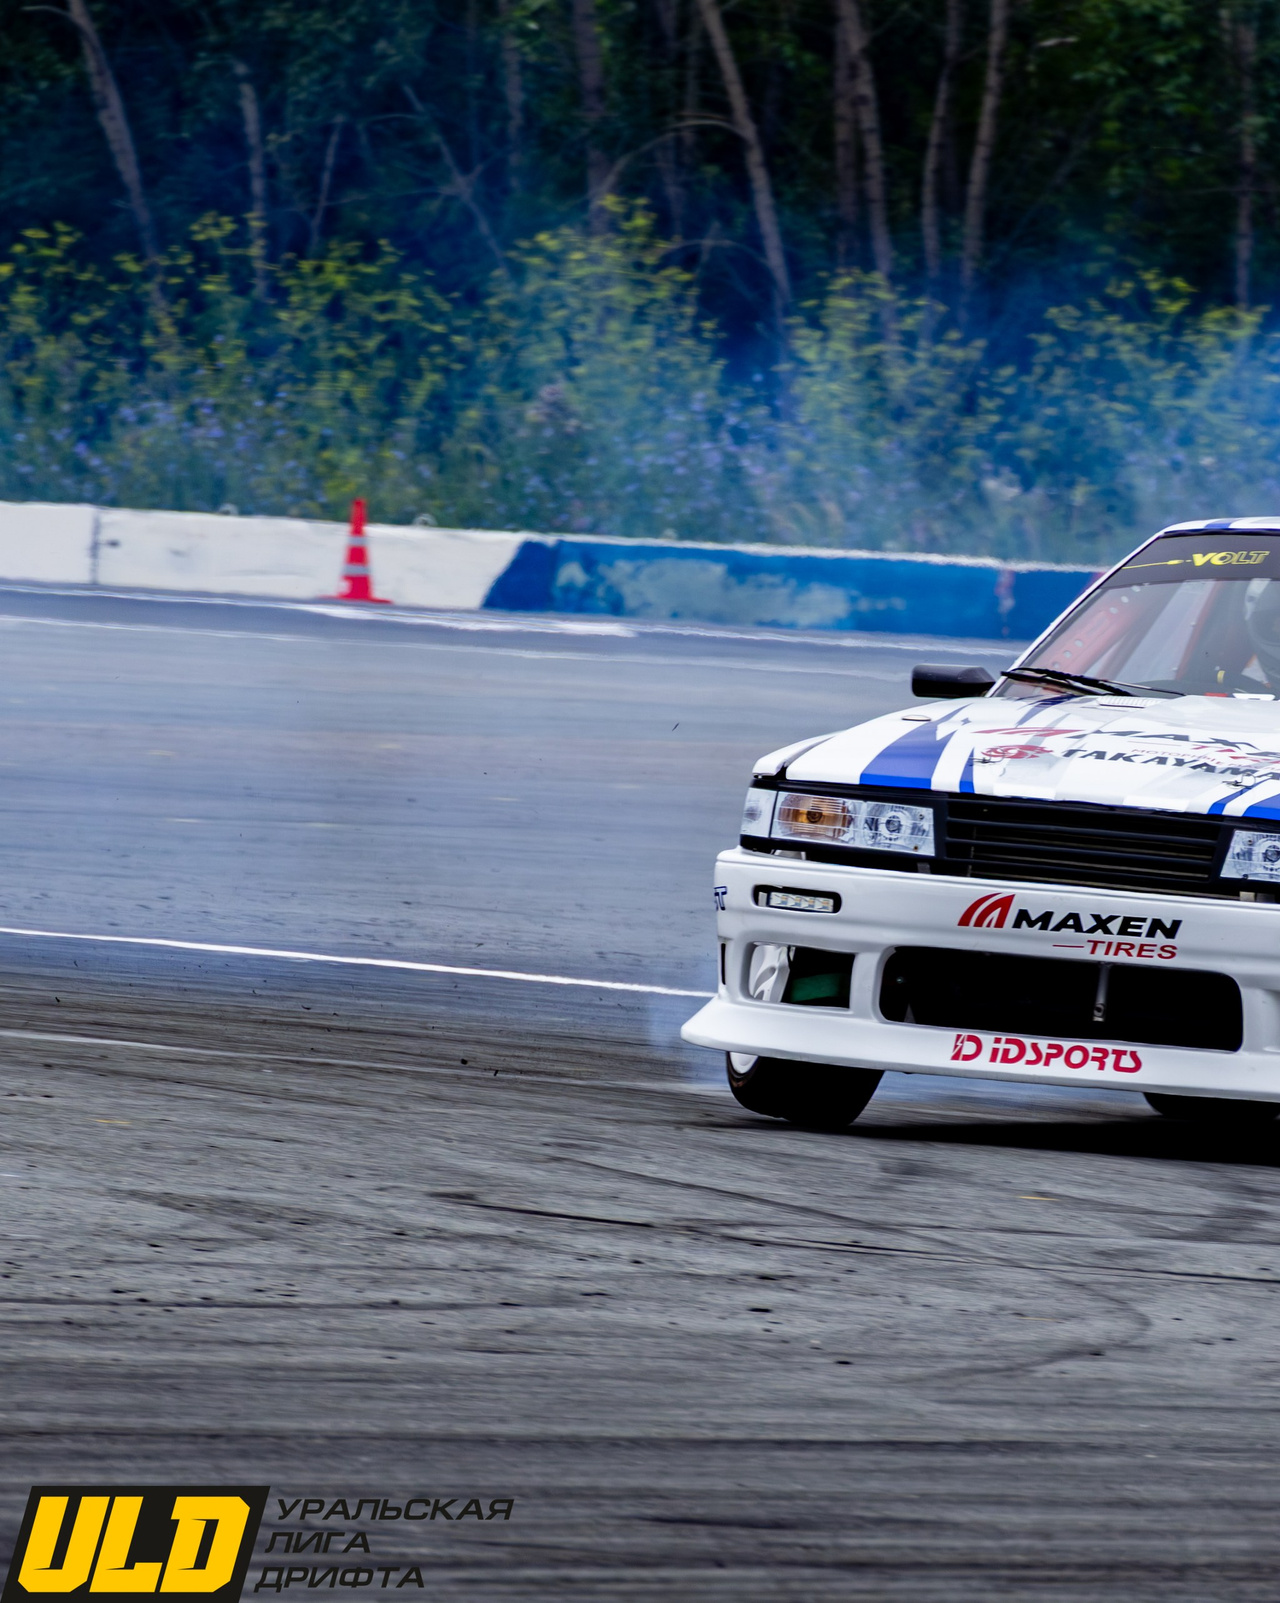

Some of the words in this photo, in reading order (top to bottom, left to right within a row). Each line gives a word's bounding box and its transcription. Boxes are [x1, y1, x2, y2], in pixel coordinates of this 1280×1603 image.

[1192, 550, 1270, 566] VOLT
[1011, 908, 1183, 940] MAXEN
[1086, 939, 1179, 960] TIRES
